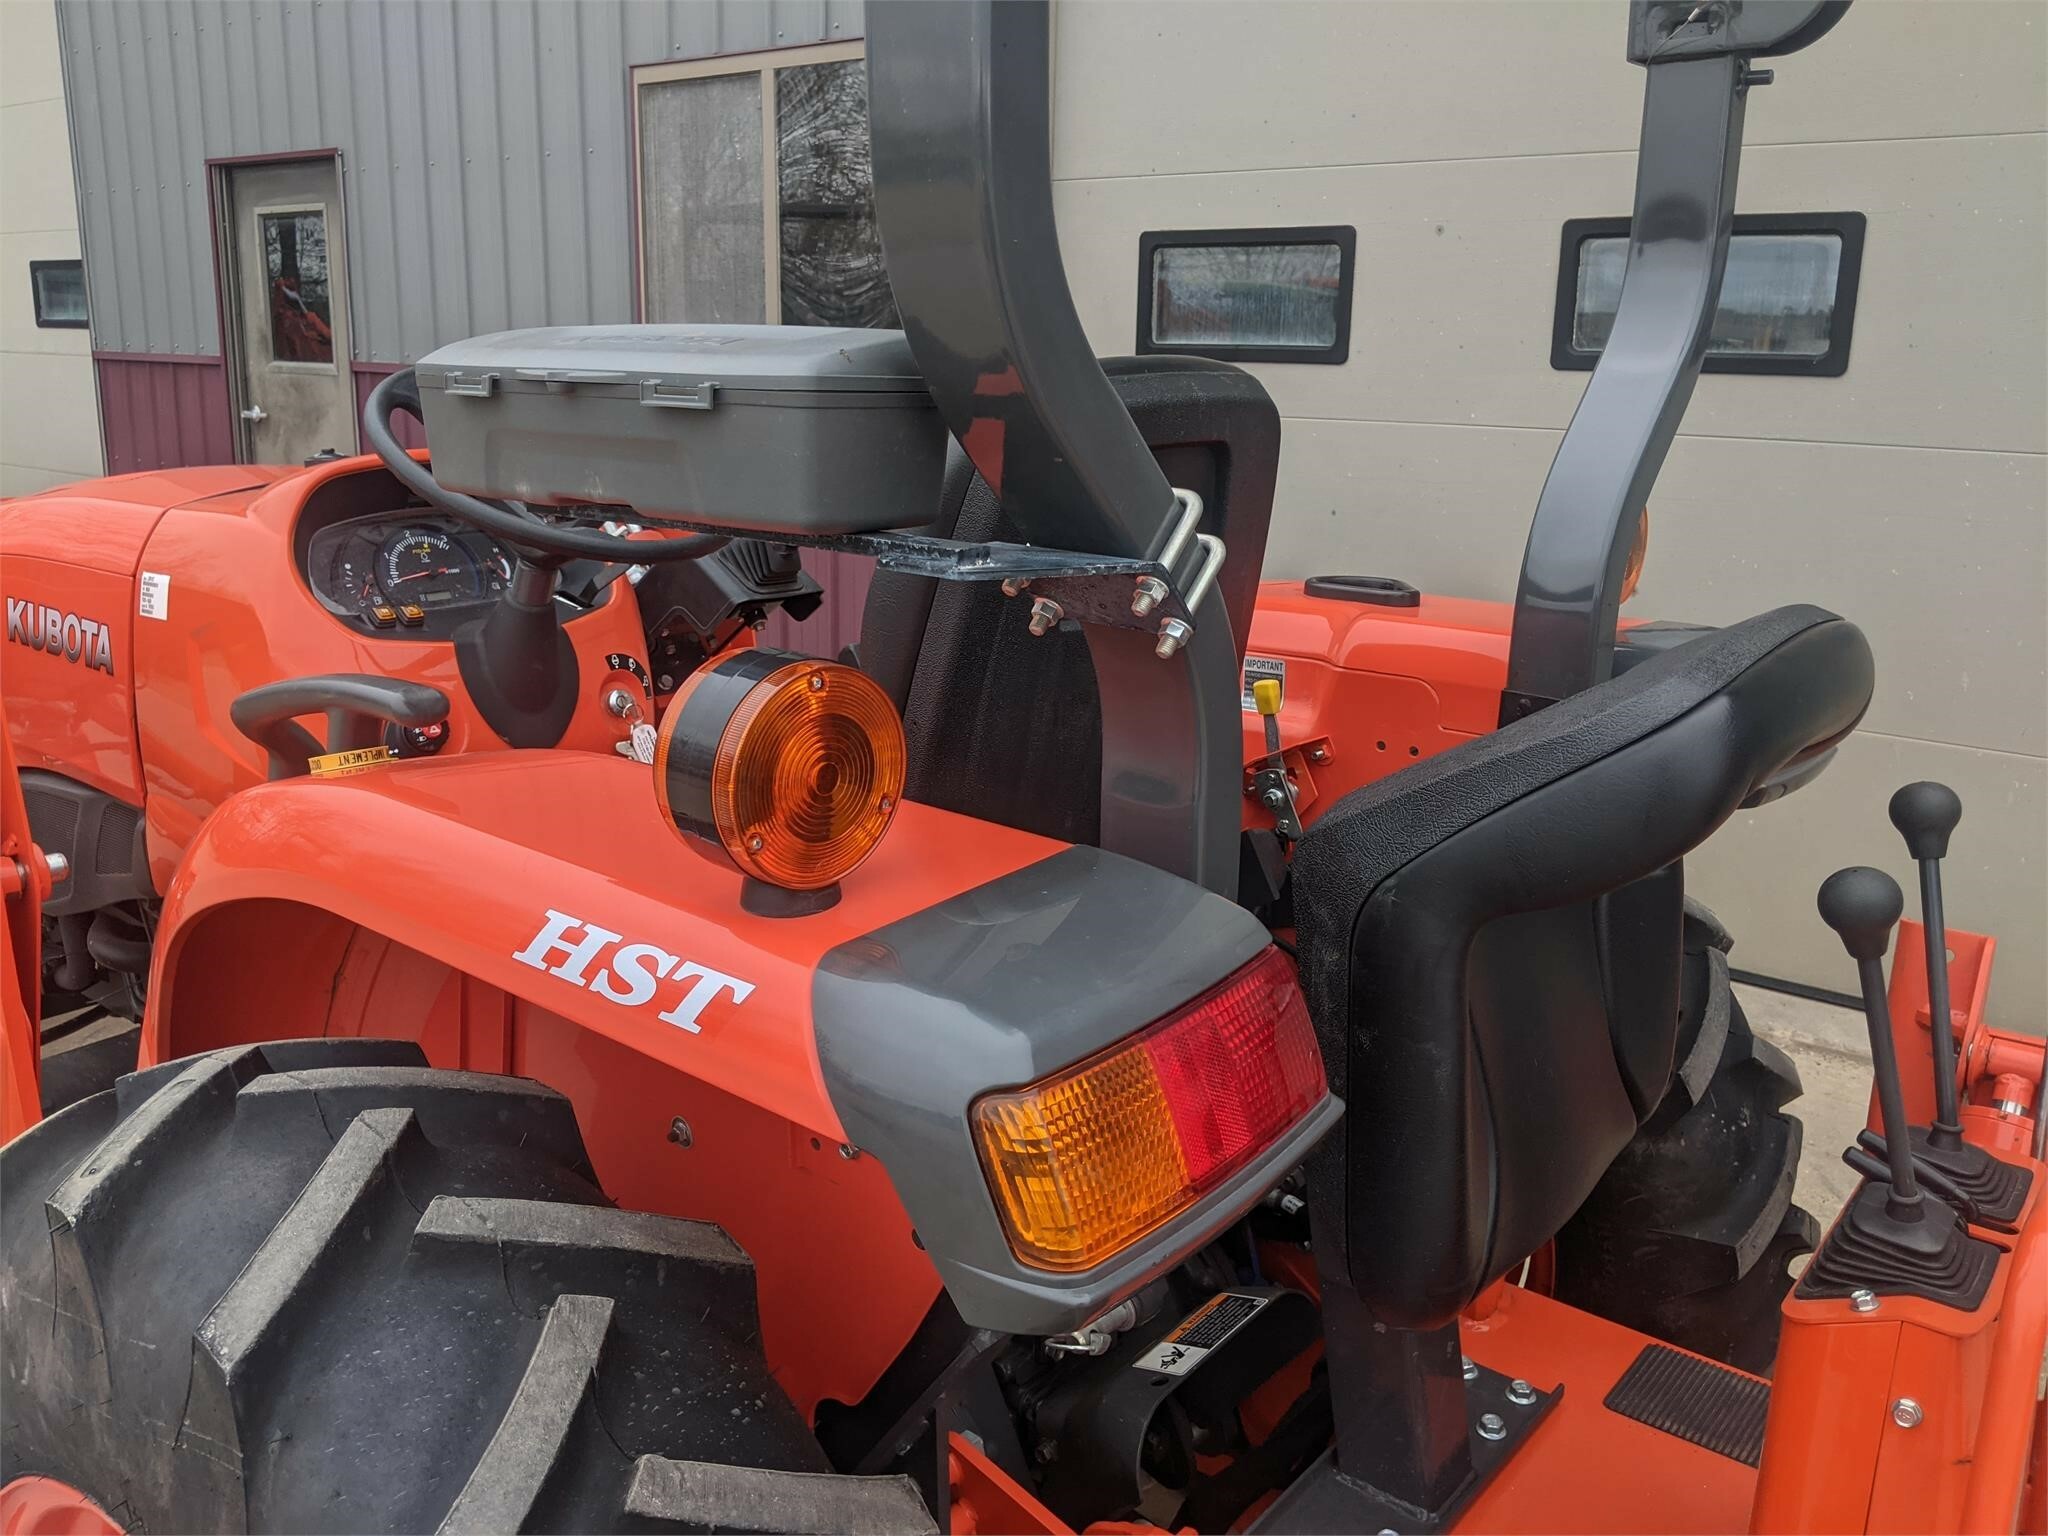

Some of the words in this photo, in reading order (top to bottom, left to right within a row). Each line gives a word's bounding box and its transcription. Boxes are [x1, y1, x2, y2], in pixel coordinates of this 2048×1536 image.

[6, 596, 114, 676] KUBOTA
[1245, 659, 1283, 671] IMPORTANT
[337, 749, 386, 767] IMPLEMENT
[511, 908, 757, 1035] HST
